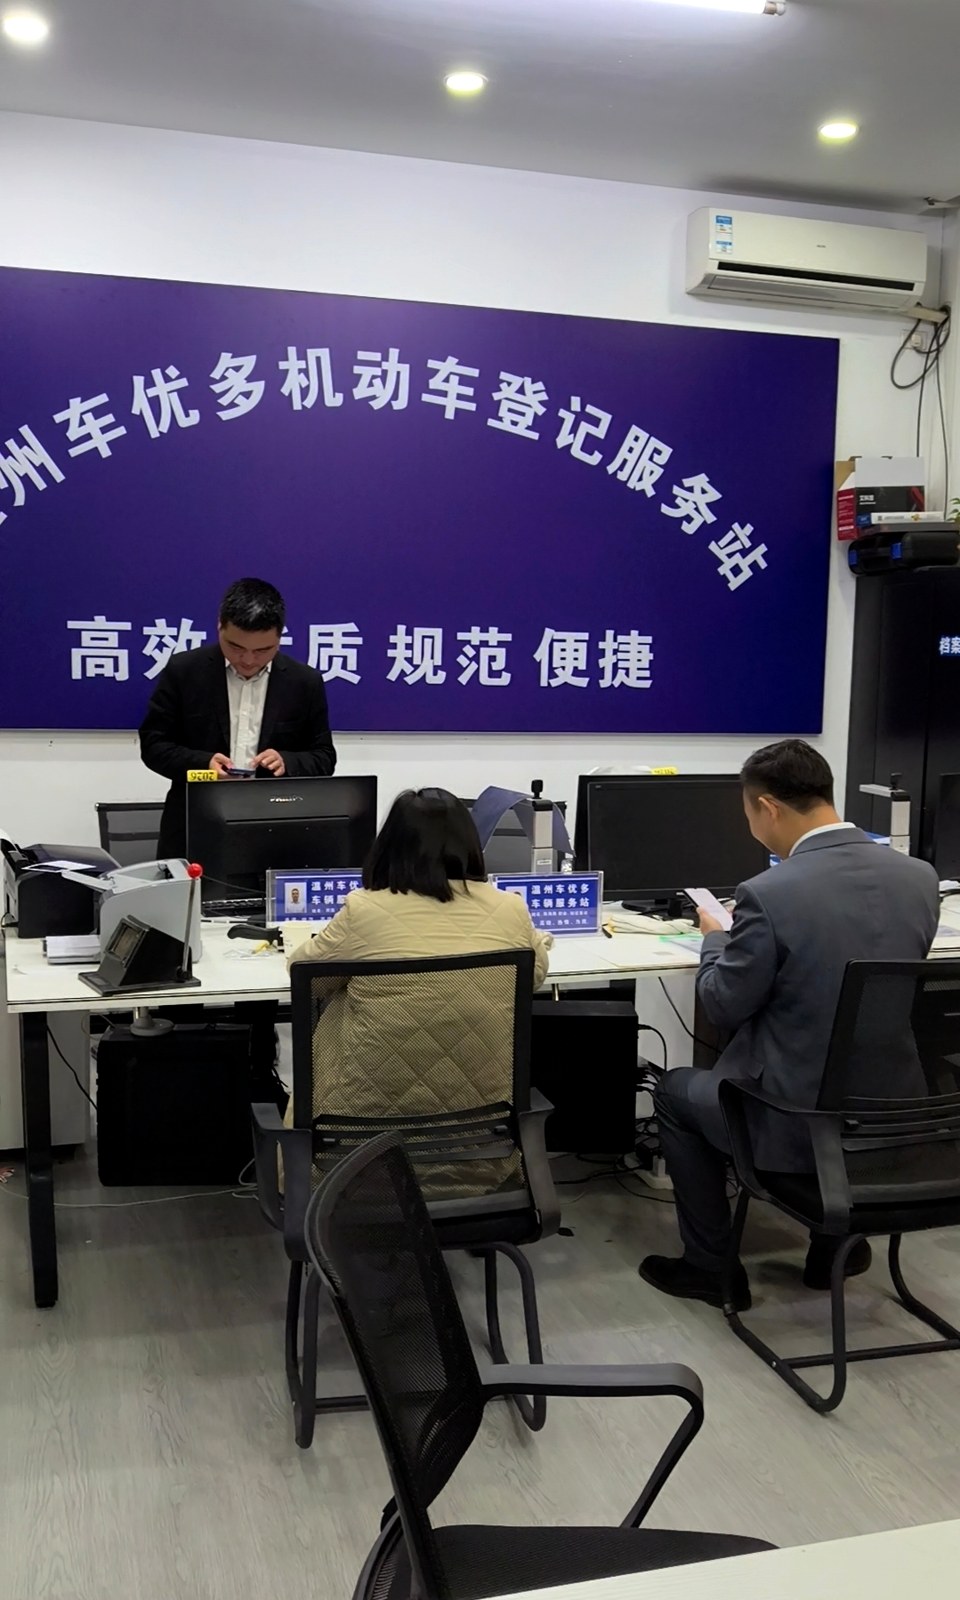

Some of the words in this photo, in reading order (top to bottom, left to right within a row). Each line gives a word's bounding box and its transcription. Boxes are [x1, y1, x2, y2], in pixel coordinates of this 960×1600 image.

[0, 345, 768, 591] 州车优多机动车登记服务站
[279, 622, 363, 685] 质
[386, 624, 513, 687] 规范
[533, 627, 654, 689] 便捷
[531, 883, 590, 895] 温州车优多
[531, 897, 590, 909] 车辆服务站
